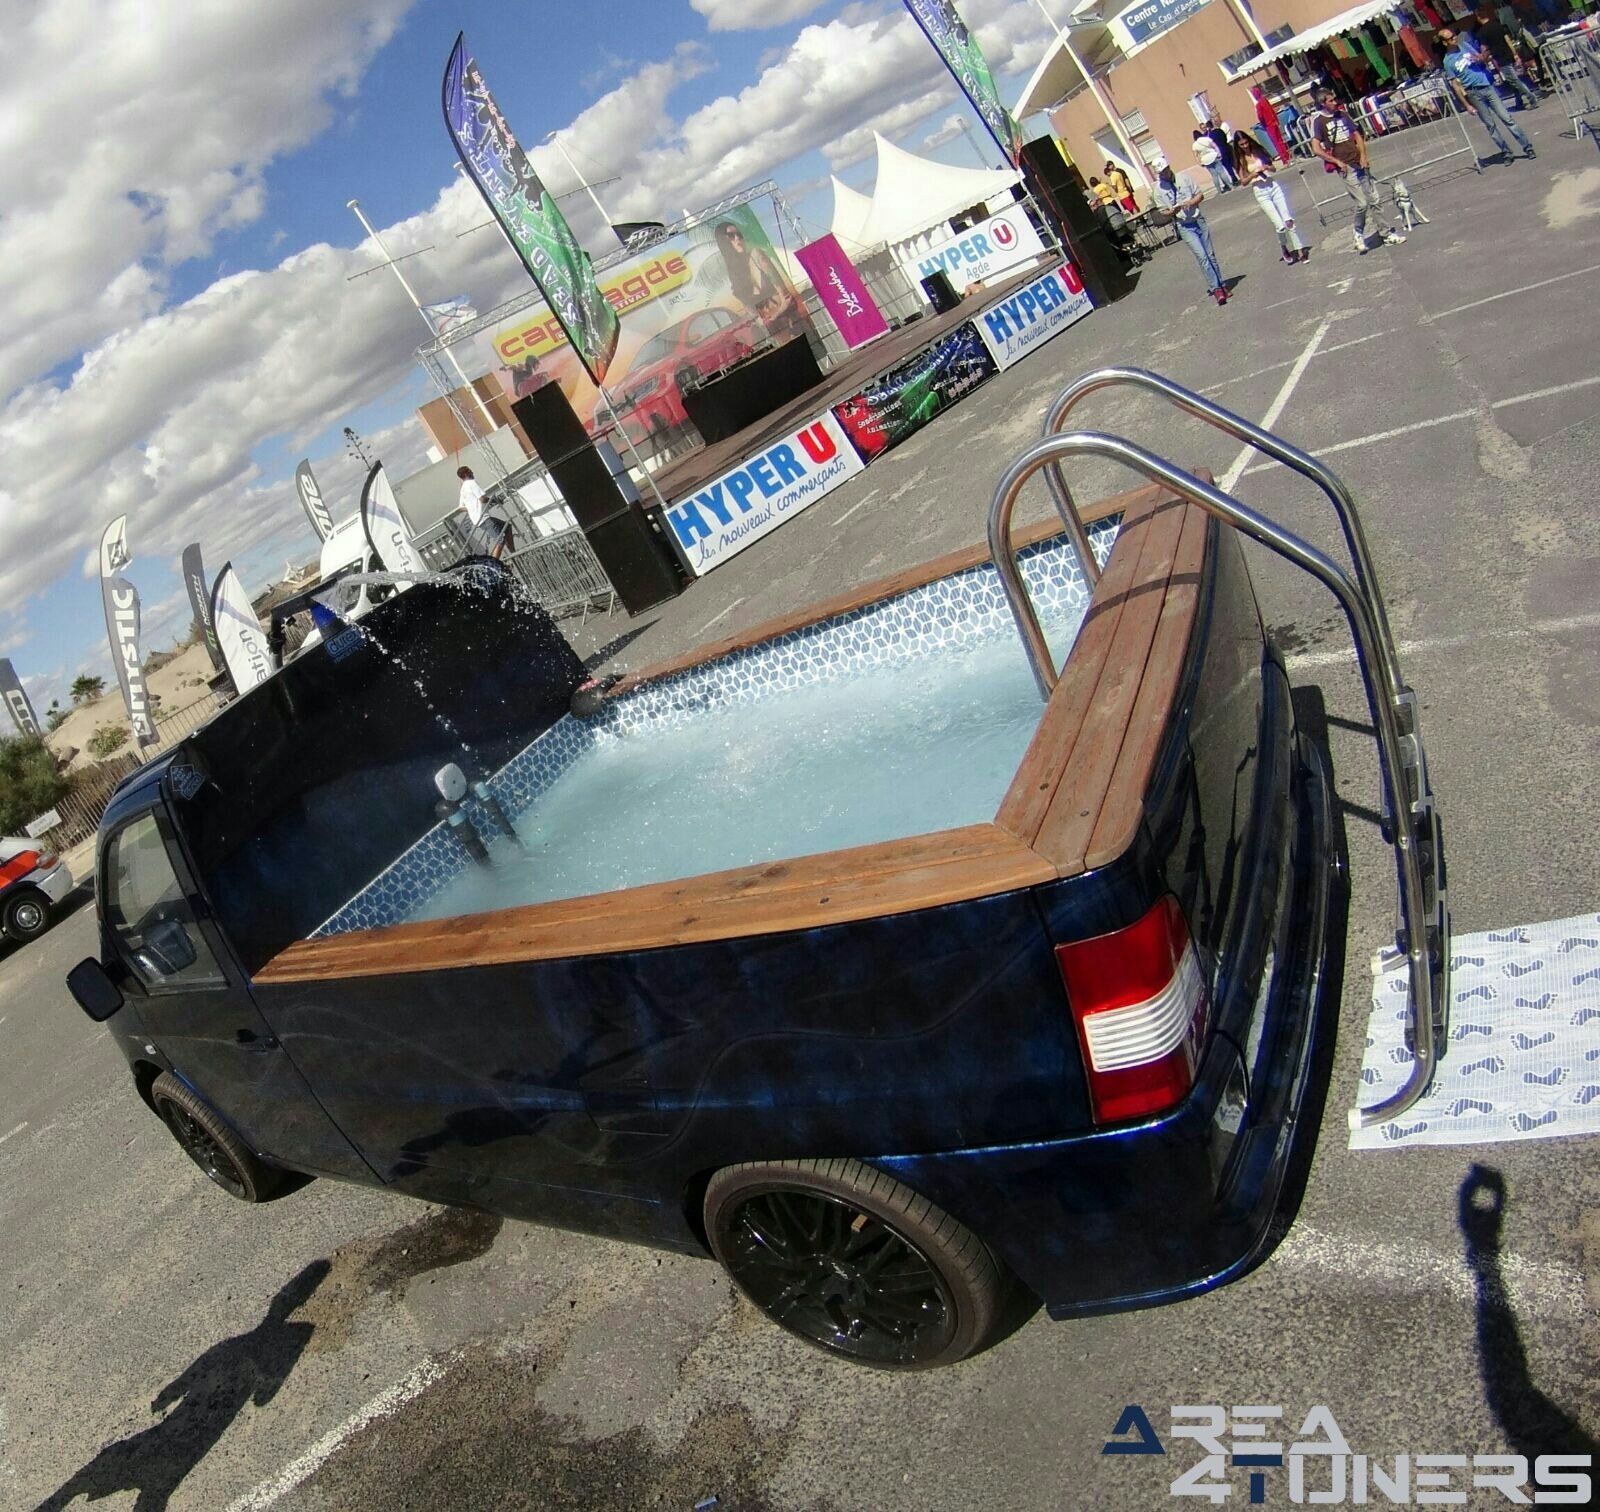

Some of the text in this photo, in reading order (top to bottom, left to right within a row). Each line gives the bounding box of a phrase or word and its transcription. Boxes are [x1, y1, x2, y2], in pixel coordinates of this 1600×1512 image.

[1127, 4, 1158, 26] Centre
[1147, 21, 1157, 30] Le
[918, 223, 1013, 278] HYPER U
[966, 261, 991, 280] Agde
[829, 266, 864, 318] Belambra
[984, 275, 1067, 345] HYPER
[1058, 263, 1084, 295] U
[667, 421, 837, 550] HYPER U
[695, 454, 847, 569] les nouveaux commerçants
[112, 589, 145, 711] MYSTIC
